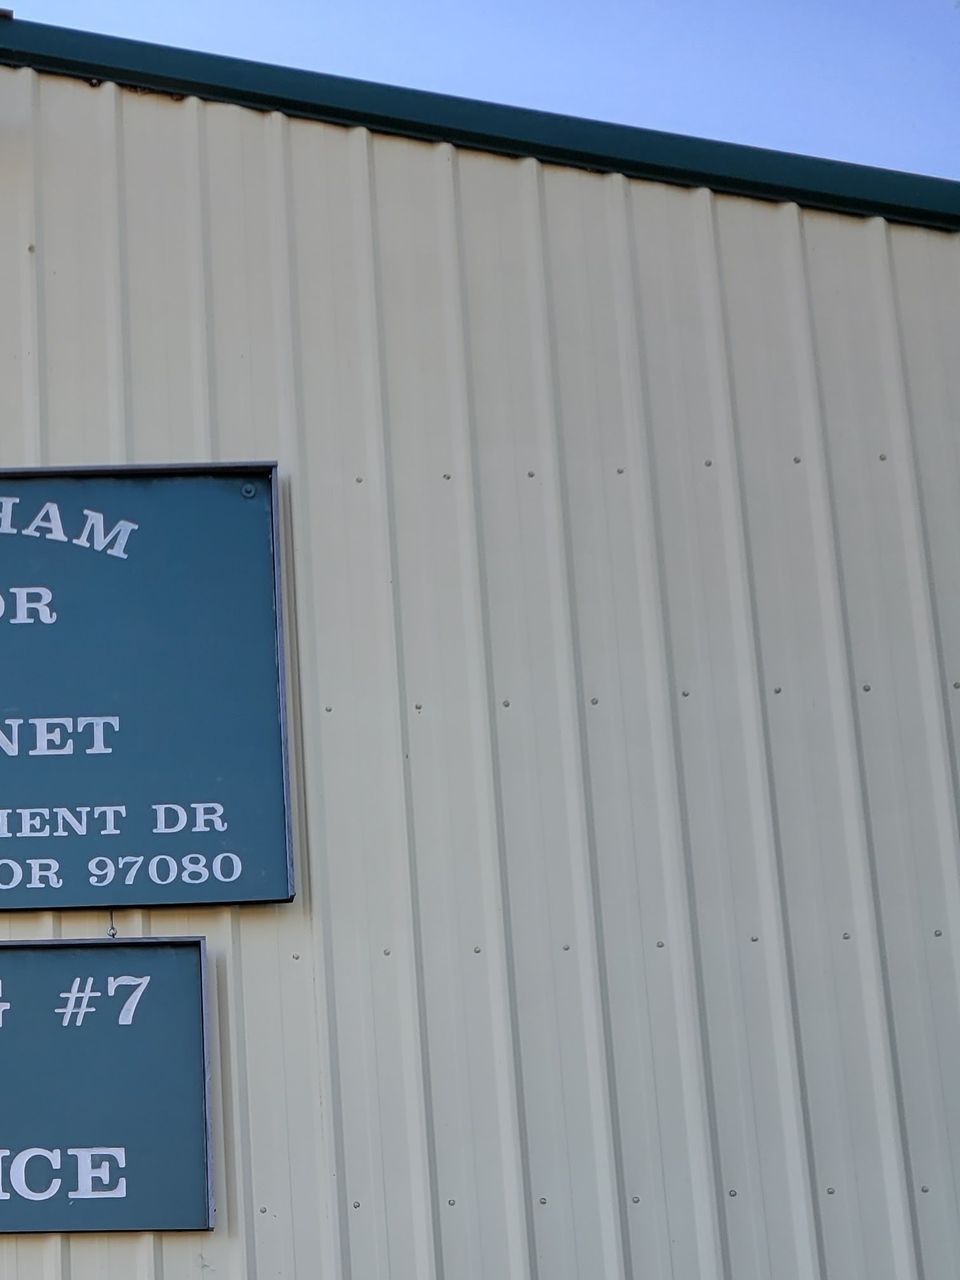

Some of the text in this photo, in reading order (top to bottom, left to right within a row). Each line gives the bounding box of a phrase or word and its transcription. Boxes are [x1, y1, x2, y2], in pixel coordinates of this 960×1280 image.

[151, 802, 228, 833] DR
[87, 852, 242, 887] 97080
[54, 975, 151, 1027] #7
